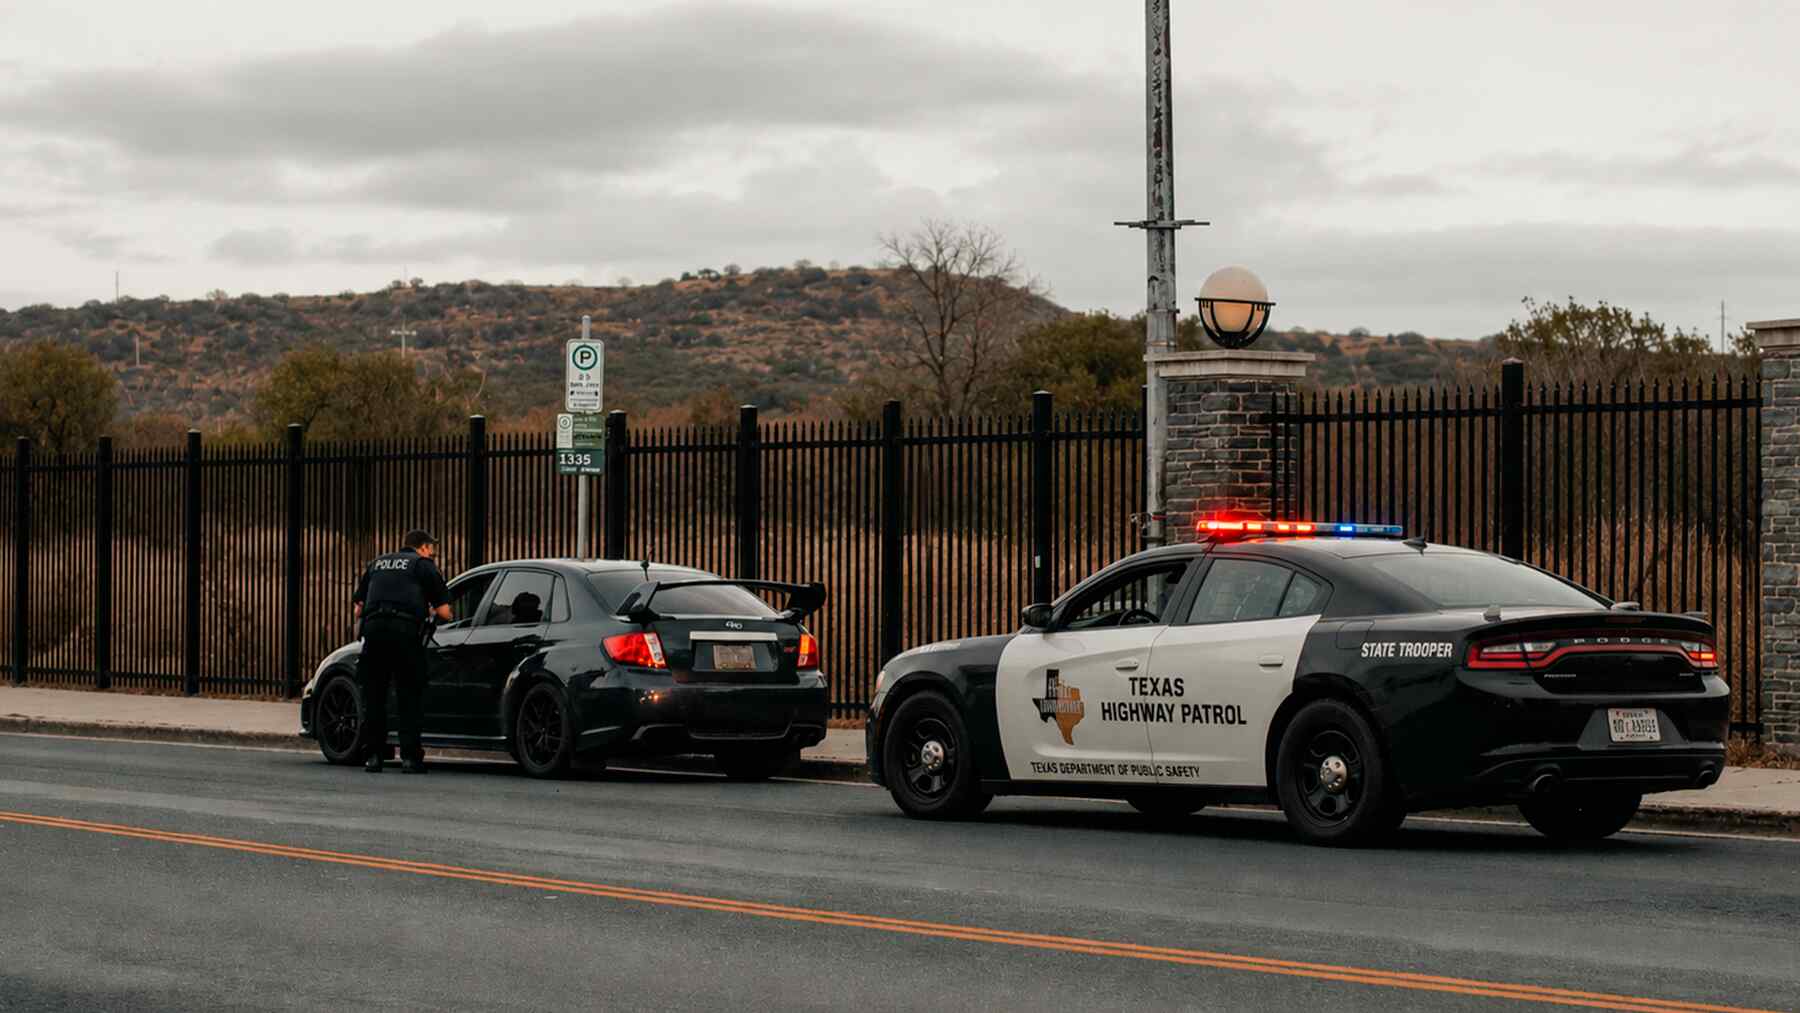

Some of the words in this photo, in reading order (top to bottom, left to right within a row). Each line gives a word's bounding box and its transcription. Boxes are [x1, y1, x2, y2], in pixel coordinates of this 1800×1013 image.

[580, 351, 592, 364] P
[560, 454, 591, 465] 1335
[375, 559, 409, 570] POLICE
[1361, 642, 1396, 657] STATE
[1399, 642, 1453, 657] TROOPER
[1128, 677, 1185, 697] TEXAS
[1101, 702, 1175, 723] HIGHWAY
[1181, 704, 1247, 725] PATROL
[1031, 762, 1058, 774] TEXAS
[1059, 763, 1115, 775] DEPARTMENT
[1118, 764, 1129, 775] OF
[1132, 765, 1164, 776] PUBLIC
[1166, 766, 1200, 777] SAFETY
